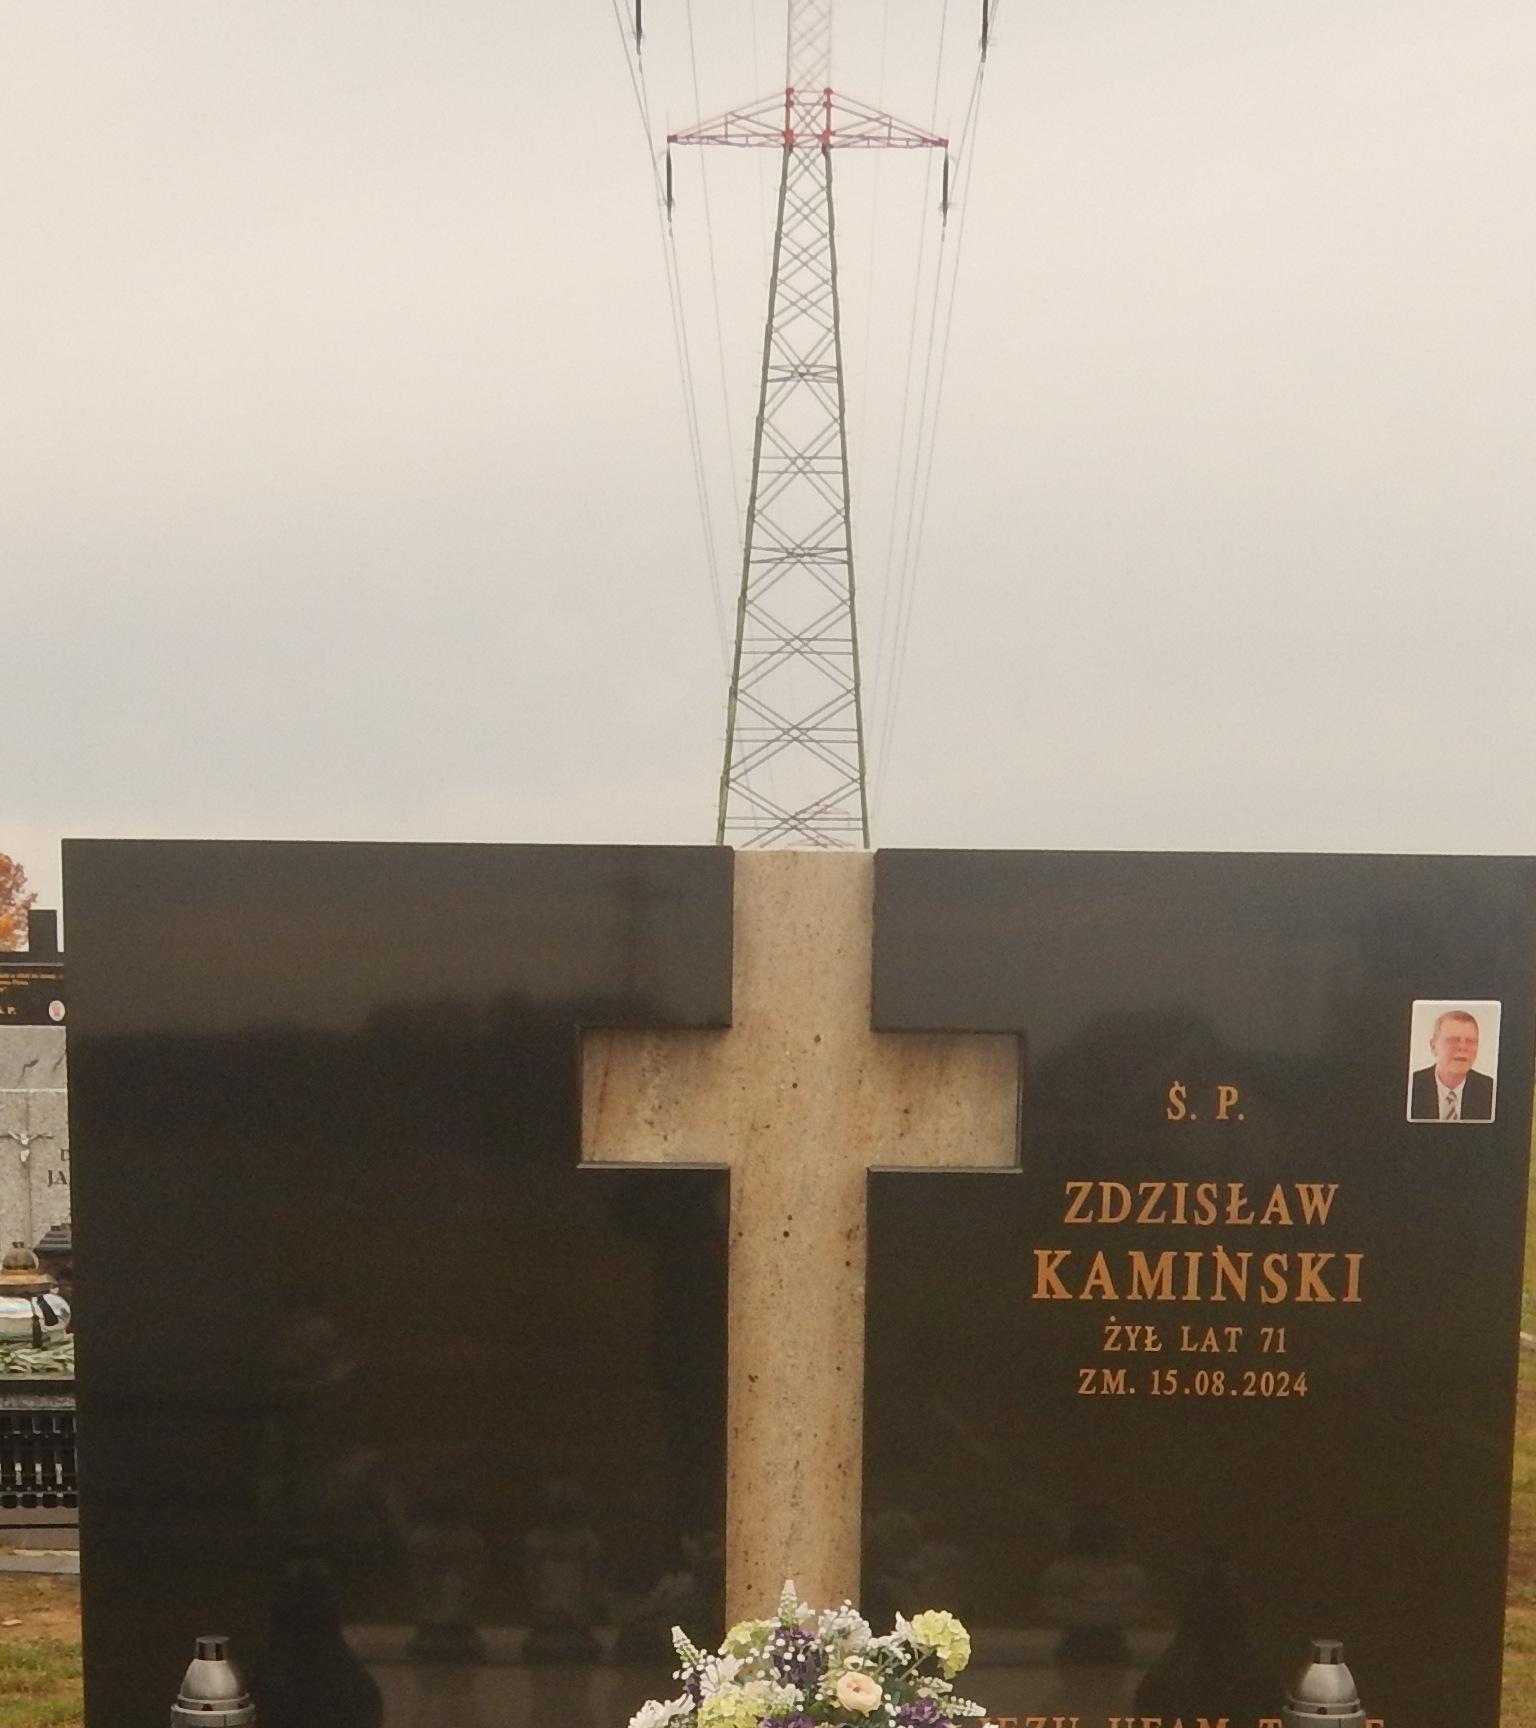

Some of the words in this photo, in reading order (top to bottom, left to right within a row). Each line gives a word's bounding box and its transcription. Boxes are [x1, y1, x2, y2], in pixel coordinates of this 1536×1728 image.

[1166, 1080, 1197, 1121] Ś.
[1216, 1085, 1246, 1121] P.
[1064, 1182, 1340, 1226] ZDZISŁAW
[1032, 1245, 1365, 1303] KAMIŃSKI
[1104, 1315, 1162, 1352] ŻYŁ
[1180, 1326, 1244, 1352] LAT
[1260, 1328, 1287, 1353] 71
[1079, 1369, 1136, 1395] ZM.
[1151, 1369, 1308, 1396] 15.08.2024
